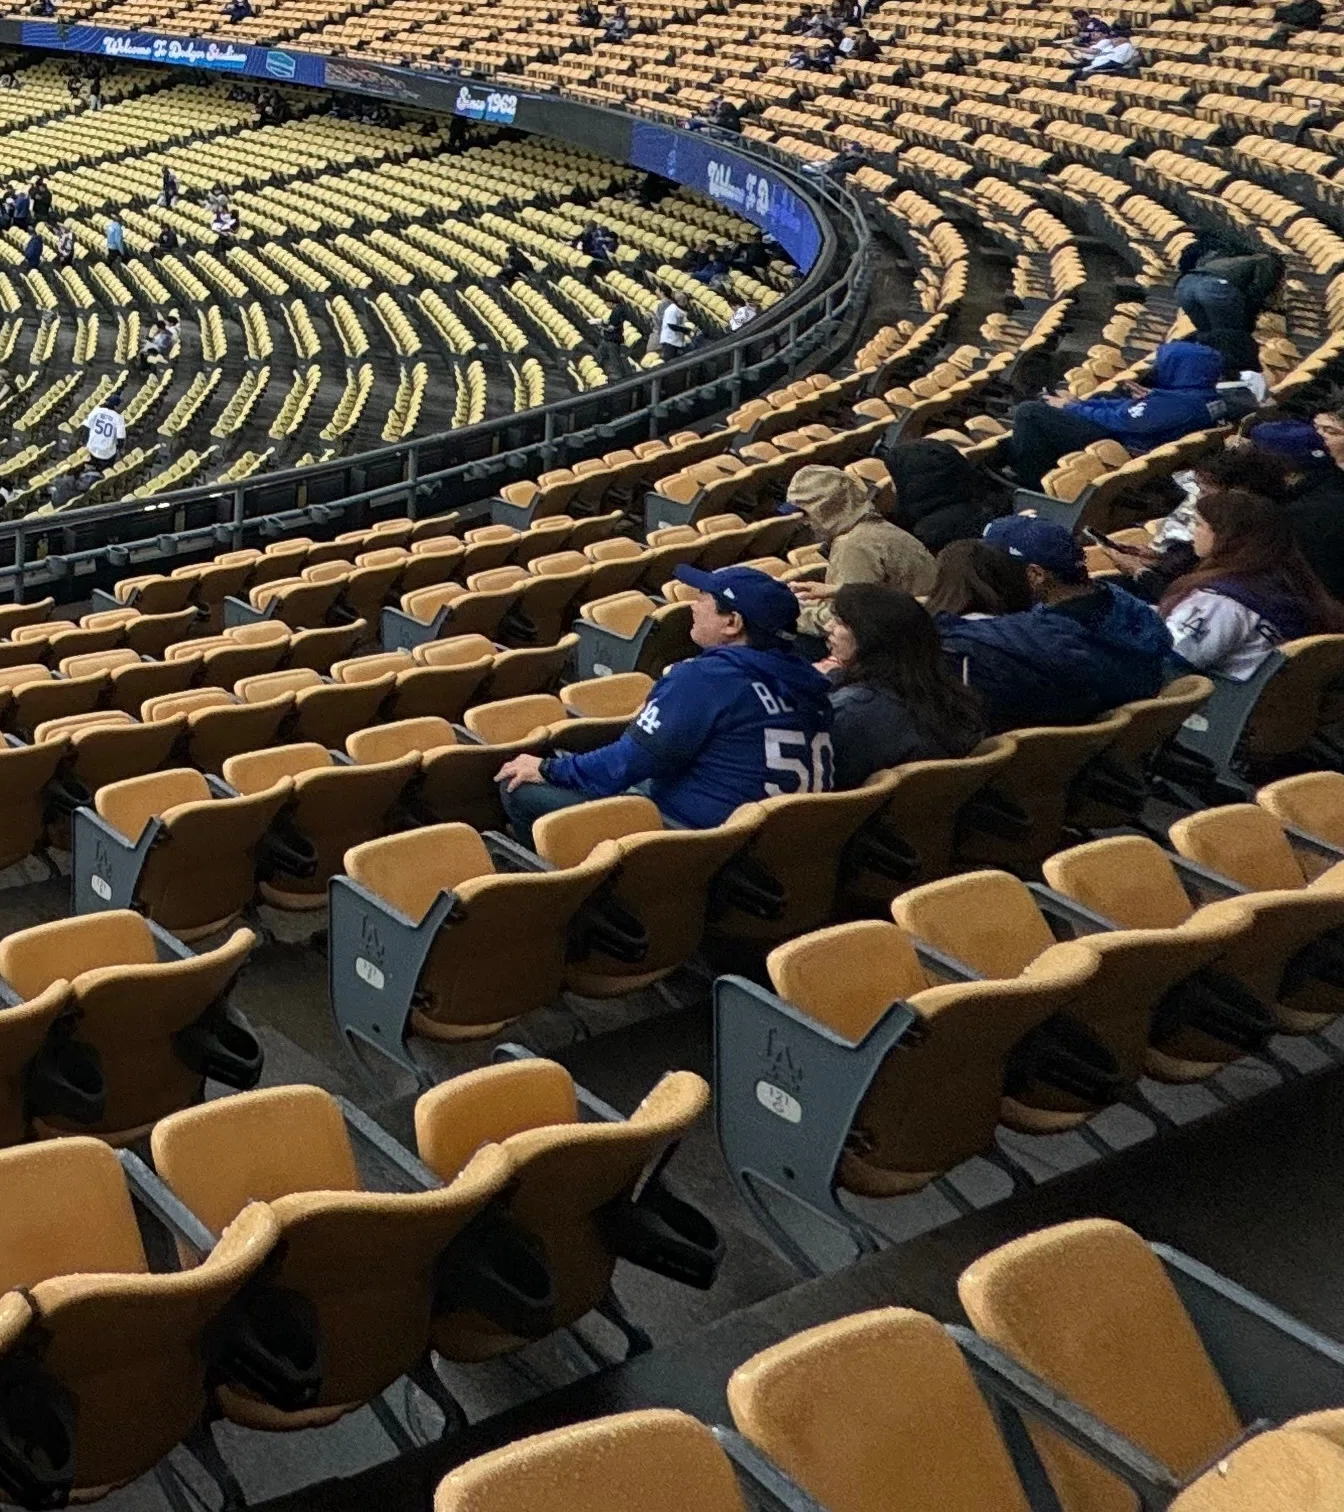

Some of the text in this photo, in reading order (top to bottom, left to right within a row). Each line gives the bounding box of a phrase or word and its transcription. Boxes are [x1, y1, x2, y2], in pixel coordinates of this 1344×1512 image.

[103, 36, 152, 56] Welcome
[152, 39, 167, 58] To
[456, 87, 518, 116] Since 1962
[94, 419, 113, 438] 50
[637, 697, 662, 735] LA
[764, 728, 835, 797] 50
